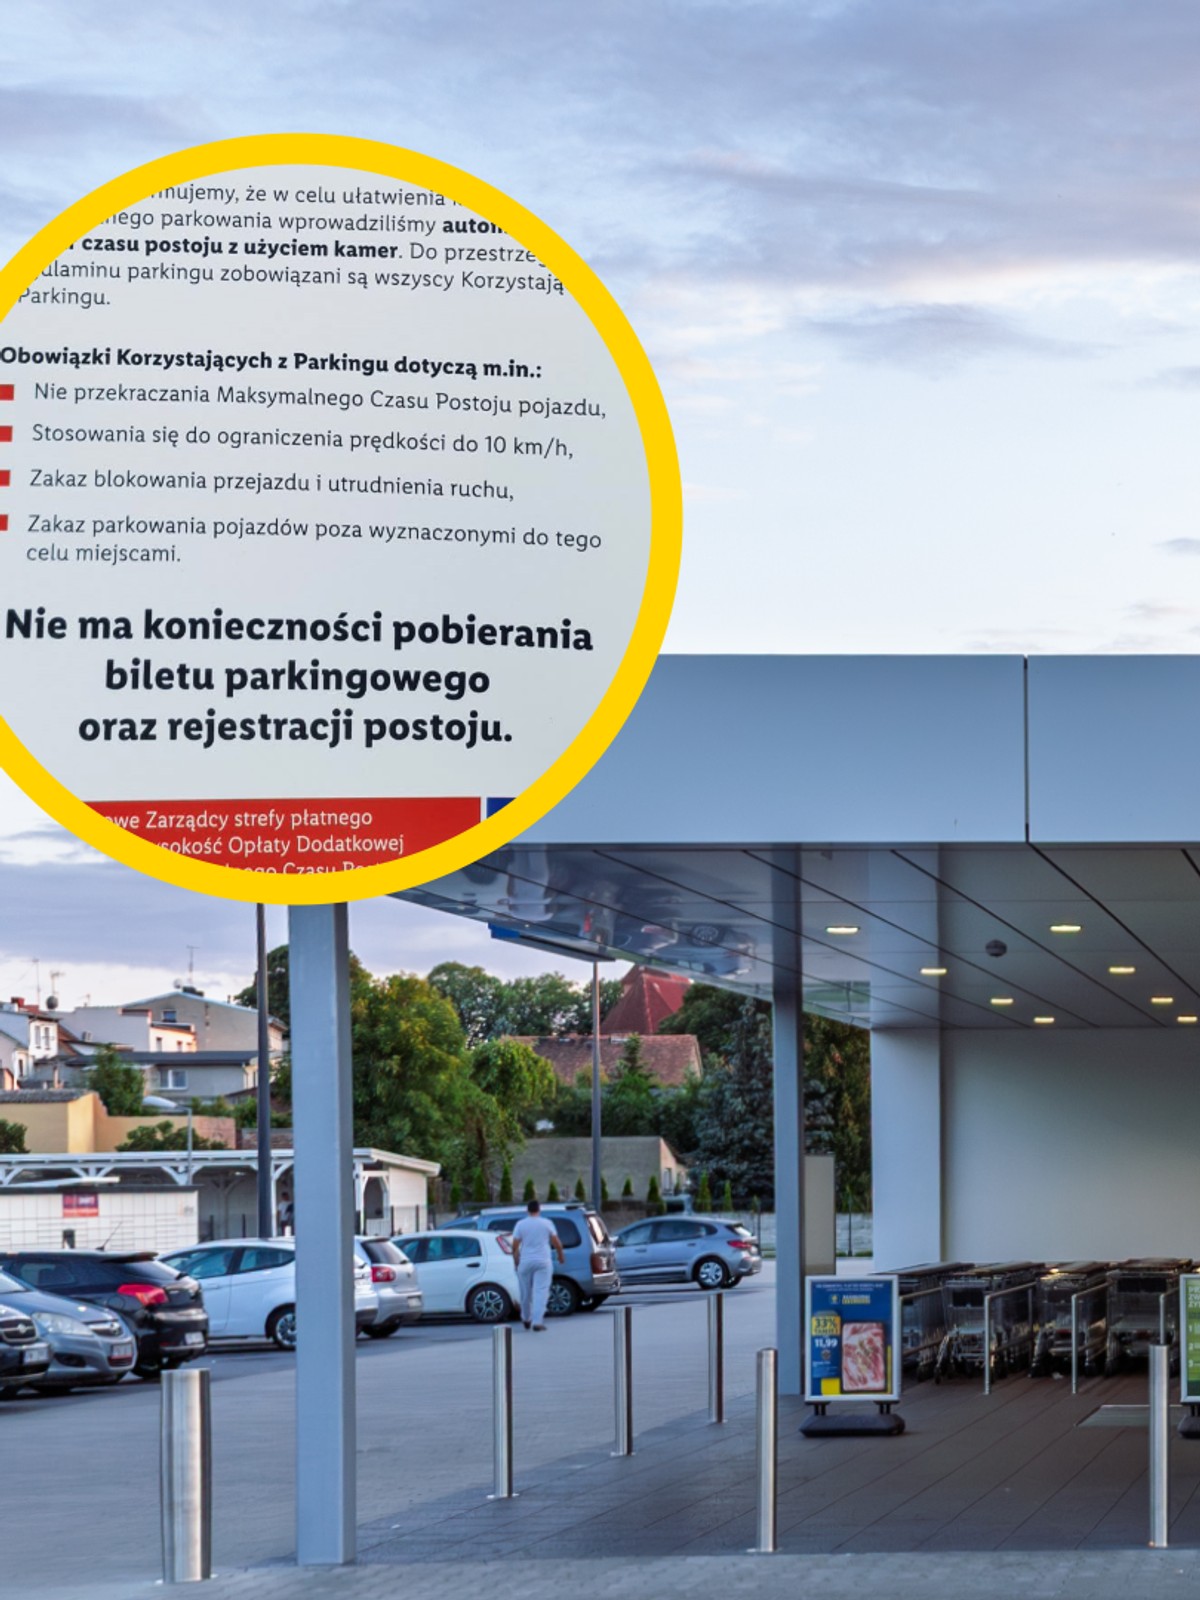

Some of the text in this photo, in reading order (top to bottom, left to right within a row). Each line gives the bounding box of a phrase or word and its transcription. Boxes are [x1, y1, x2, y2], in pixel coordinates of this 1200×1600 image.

[151, 184, 445, 205] mujemy, że w celu ułatwienia
[101, 212, 154, 229] ego
[161, 210, 272, 229] parkowania
[279, 214, 435, 236] wprowadziliśmy
[82, 238, 139, 251] czasu
[145, 236, 223, 257] postoju
[228, 242, 238, 254] z
[244, 239, 328, 259] użyciem
[334, 240, 402, 258] kamer.
[410, 242, 437, 260] Do
[445, 247, 546, 267] przestrze
[34, 260, 563, 295] ulaminu parkingu zobowiązani są wszyscy Korzystają
[19, 288, 110, 309] Parkingu.
[0, 347, 541, 380] Obowiązki Korzystających z Parkingu dotyczą m.in.:
[36, 383, 605, 419] Nie przekraczania Maksymalnego Czasu Postoju pojazdu,
[33, 424, 573, 459] Stosowania się do ograniczenia prędkości do 10 km/h,
[30, 469, 513, 501] Zakaz blokowania przejazdu i utrudnienia ruchu,
[28, 515, 601, 552] Zakaz parkowania pojazdów poza wyznaczonymi do tego
[27, 544, 180, 565] celu miejscami.
[6, 607, 593, 651] Nie ma konieczności pobierania
[106, 657, 490, 700] biletu parkingowego
[79, 708, 512, 749] oraz rejestracji postoju.
[146, 810, 228, 832] Zarządcy
[235, 809, 284, 830] strefy
[291, 809, 372, 830] płatnego
[157, 835, 403, 857] sokość Opłaty Dodatkowej
